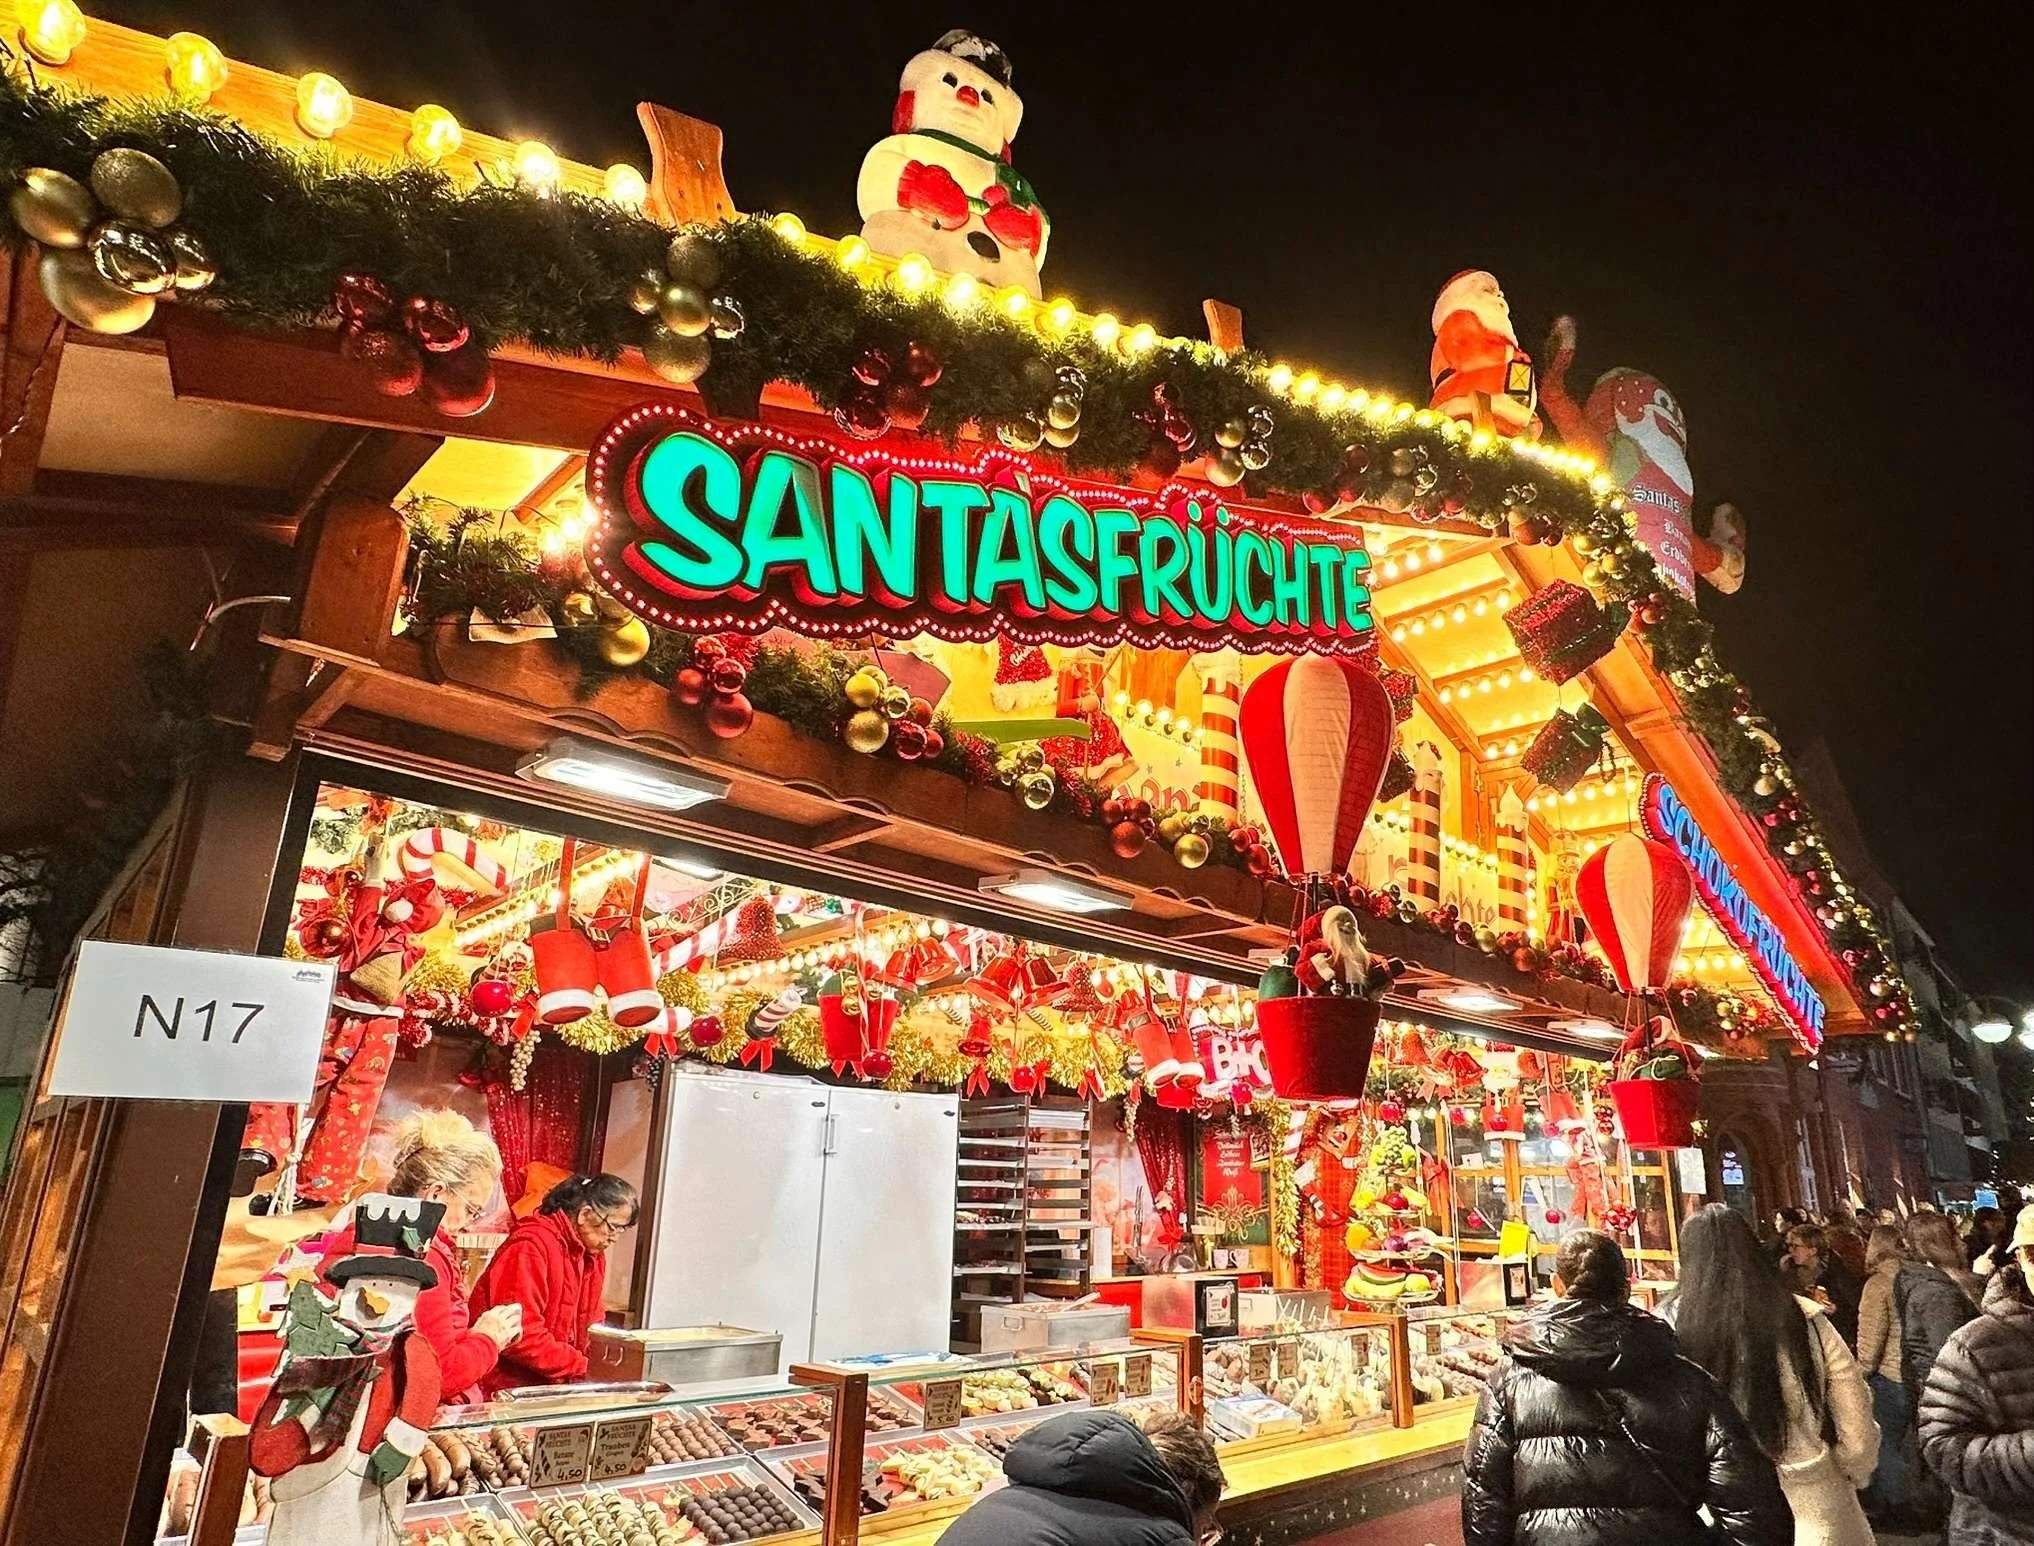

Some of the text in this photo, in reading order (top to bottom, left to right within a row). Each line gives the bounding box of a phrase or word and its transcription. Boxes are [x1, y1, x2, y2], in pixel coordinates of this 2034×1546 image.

[1632, 484, 1681, 513] Santas
[134, 994, 265, 1044] N17
[557, 1467, 583, 1481] 4,50
